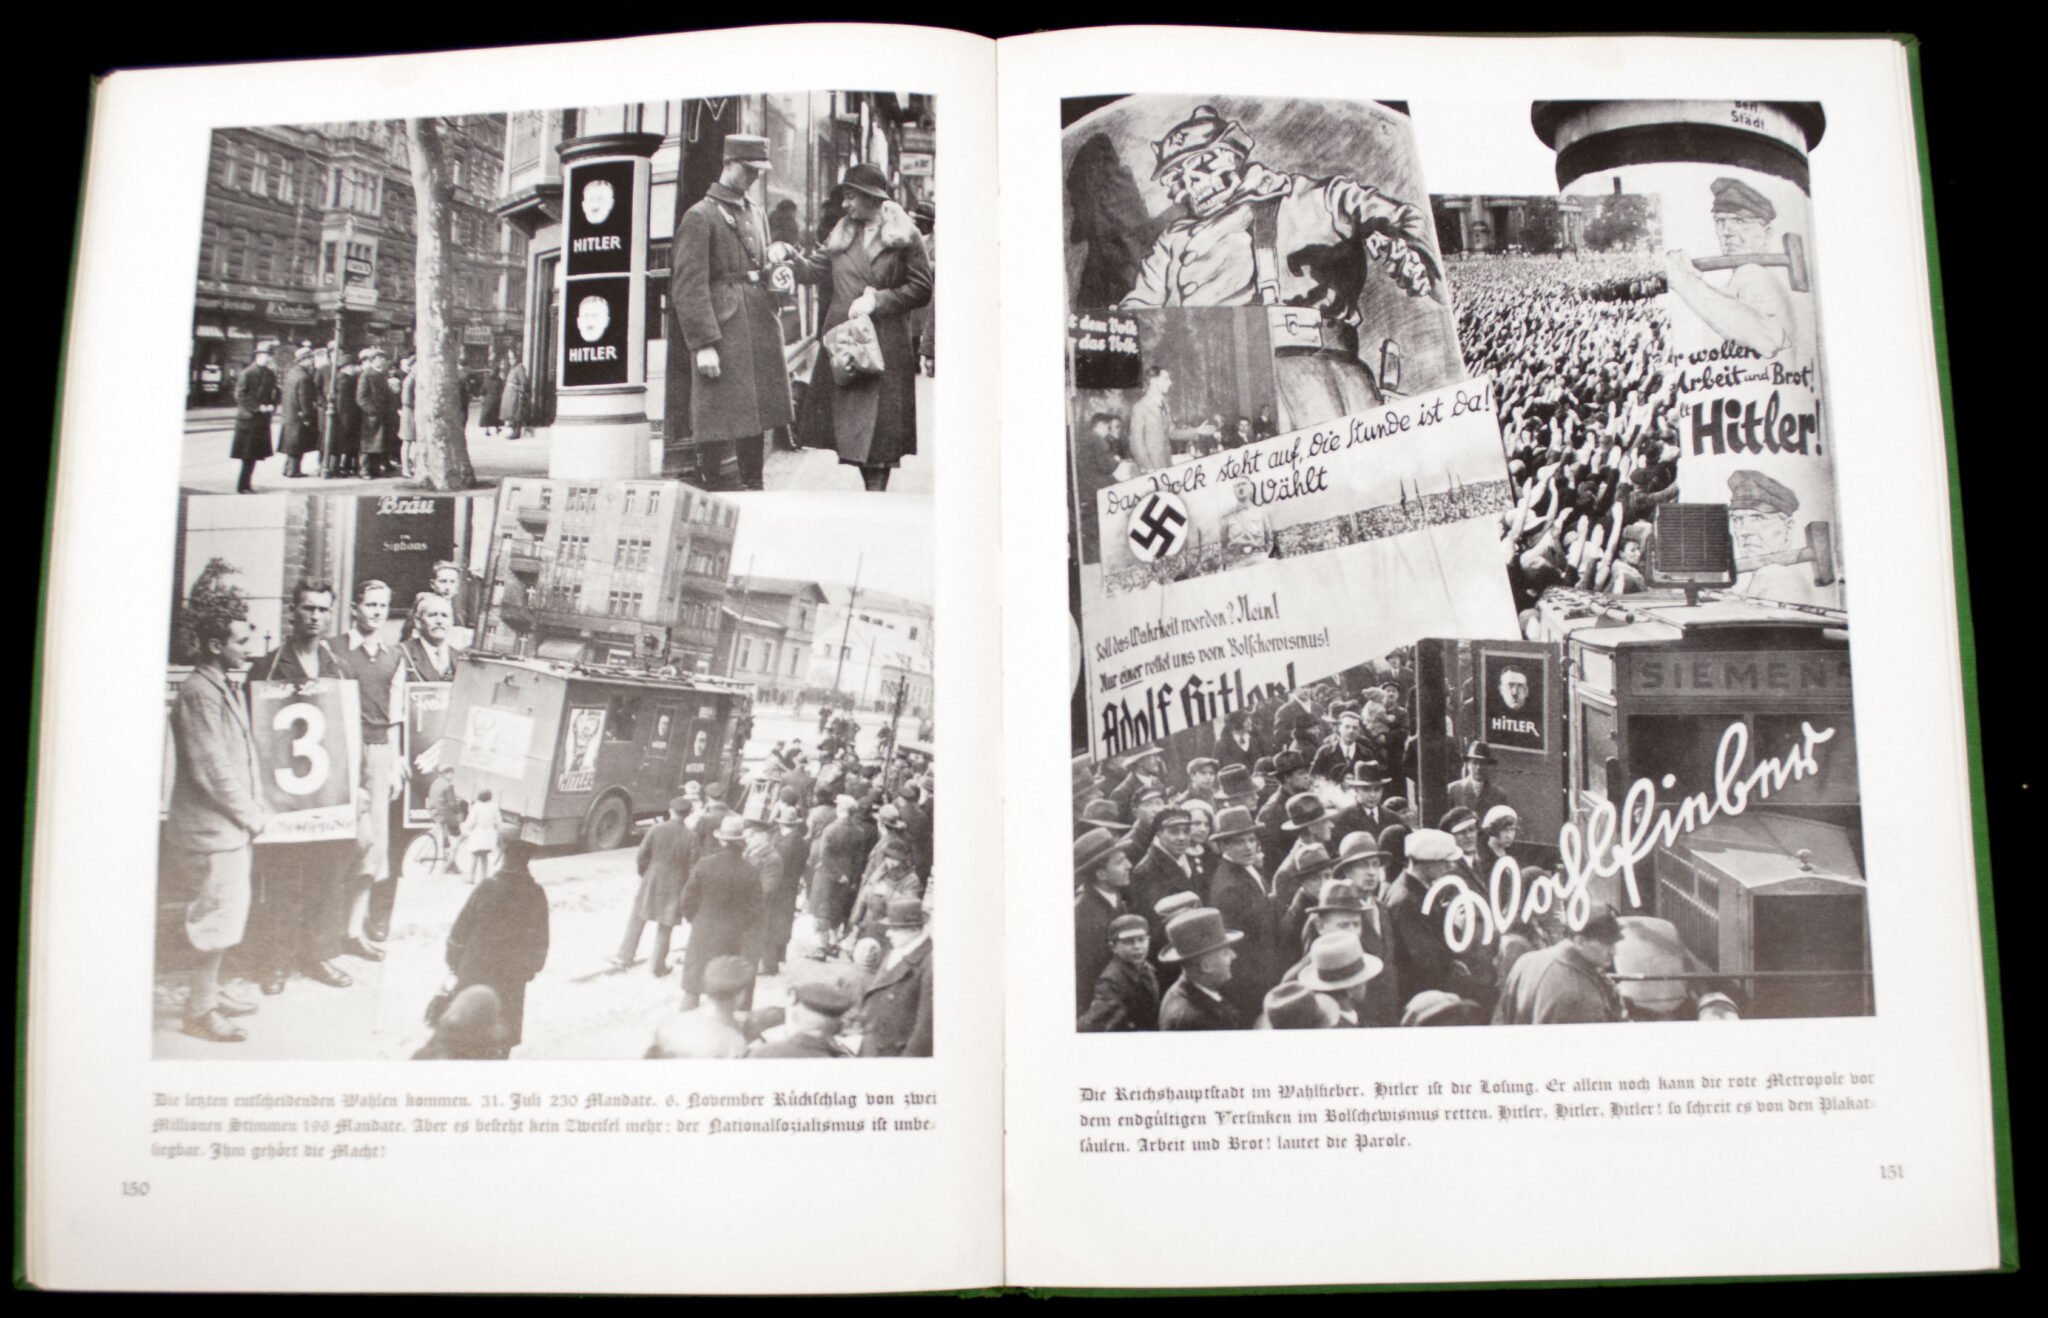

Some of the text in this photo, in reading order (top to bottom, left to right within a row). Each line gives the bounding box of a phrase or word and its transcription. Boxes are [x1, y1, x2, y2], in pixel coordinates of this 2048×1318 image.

[573, 235, 622, 253] HITLER
[568, 345, 617, 362] HITLER
[1688, 338, 1763, 366] wollen
[1670, 357, 1816, 394] Arbeit und Brot!
[1691, 389, 1823, 457] Hitler!
[1148, 465, 1206, 496] Volk
[1216, 449, 1263, 482] steht
[1268, 436, 1303, 471] auf,
[1346, 410, 1410, 449] Stunde
[1417, 396, 1444, 427] ist
[1250, 465, 1328, 507] Wählt
[376, 496, 435, 515] Bräu
[1236, 592, 1280, 623] Nein!
[1171, 650, 1196, 669] uns
[1102, 681, 1174, 758] Adolf
[272, 702, 331, 796] 3
[1078, 1086, 1108, 1103] Die
[1251, 1087, 1272, 1100] im
[1373, 1081, 1420, 1100] Hitler
[1450, 1081, 1473, 1095] die
[1544, 1077, 1567, 1093] Er
[1572, 1077, 1613, 1092] allein
[1618, 1076, 1651, 1091] noch
[1657, 1075, 1696, 1091] kann
[1700, 1075, 1723, 1089] die
[1727, 1075, 1758, 1089] rote
[1765, 1071, 1845, 1090] Metropole
[1849, 1072, 1875, 1085] vor
[152, 1092, 180, 1108] Die
[341, 1092, 399, 1109] Wahlen
[404, 1092, 473, 1108] kommen.
[480, 1094, 505, 1108] 31.
[509, 1091, 542, 1112] Juli
[549, 1093, 580, 1108] 230
[583, 1092, 657, 1110] Mandate.
[664, 1093, 680, 1108] 6.
[686, 1091, 766, 1110] November
[864, 1092, 896, 1107] von
[902, 1090, 938, 1109] zwei
[1079, 1113, 1112, 1128] dem
[1297, 1112, 1318, 1125] im
[1443, 1108, 1493, 1121] retten.
[1609, 1101, 1662, 1119] Hitler!
[1735, 1101, 1753, 1114] es
[1755, 1100, 1784, 1113] von
[1787, 1098, 1814, 1112] den
[151, 1117, 223, 1134] Millionen
[227, 1117, 298, 1133] Stimmen
[333, 1118, 407, 1136] Mandate.
[412, 1117, 449, 1134] Aber
[452, 1119, 471, 1134] es
[528, 1118, 561, 1134] kein
[564, 1117, 621, 1134] Zweifel
[675, 1119, 701, 1134] der
[209, 1141, 247, 1161] Ihm
[303, 1144, 326, 1158] die
[329, 1143, 387, 1161] Macht!
[1136, 1137, 1186, 1153] Arbeit
[1191, 1137, 1221, 1152] und
[1276, 1135, 1321, 1150] lautet
[1325, 1135, 1349, 1150] die
[1354, 1132, 1412, 1153] Parole.
[1880, 1164, 1905, 1181] 151
[122, 1181, 151, 1197] 150
